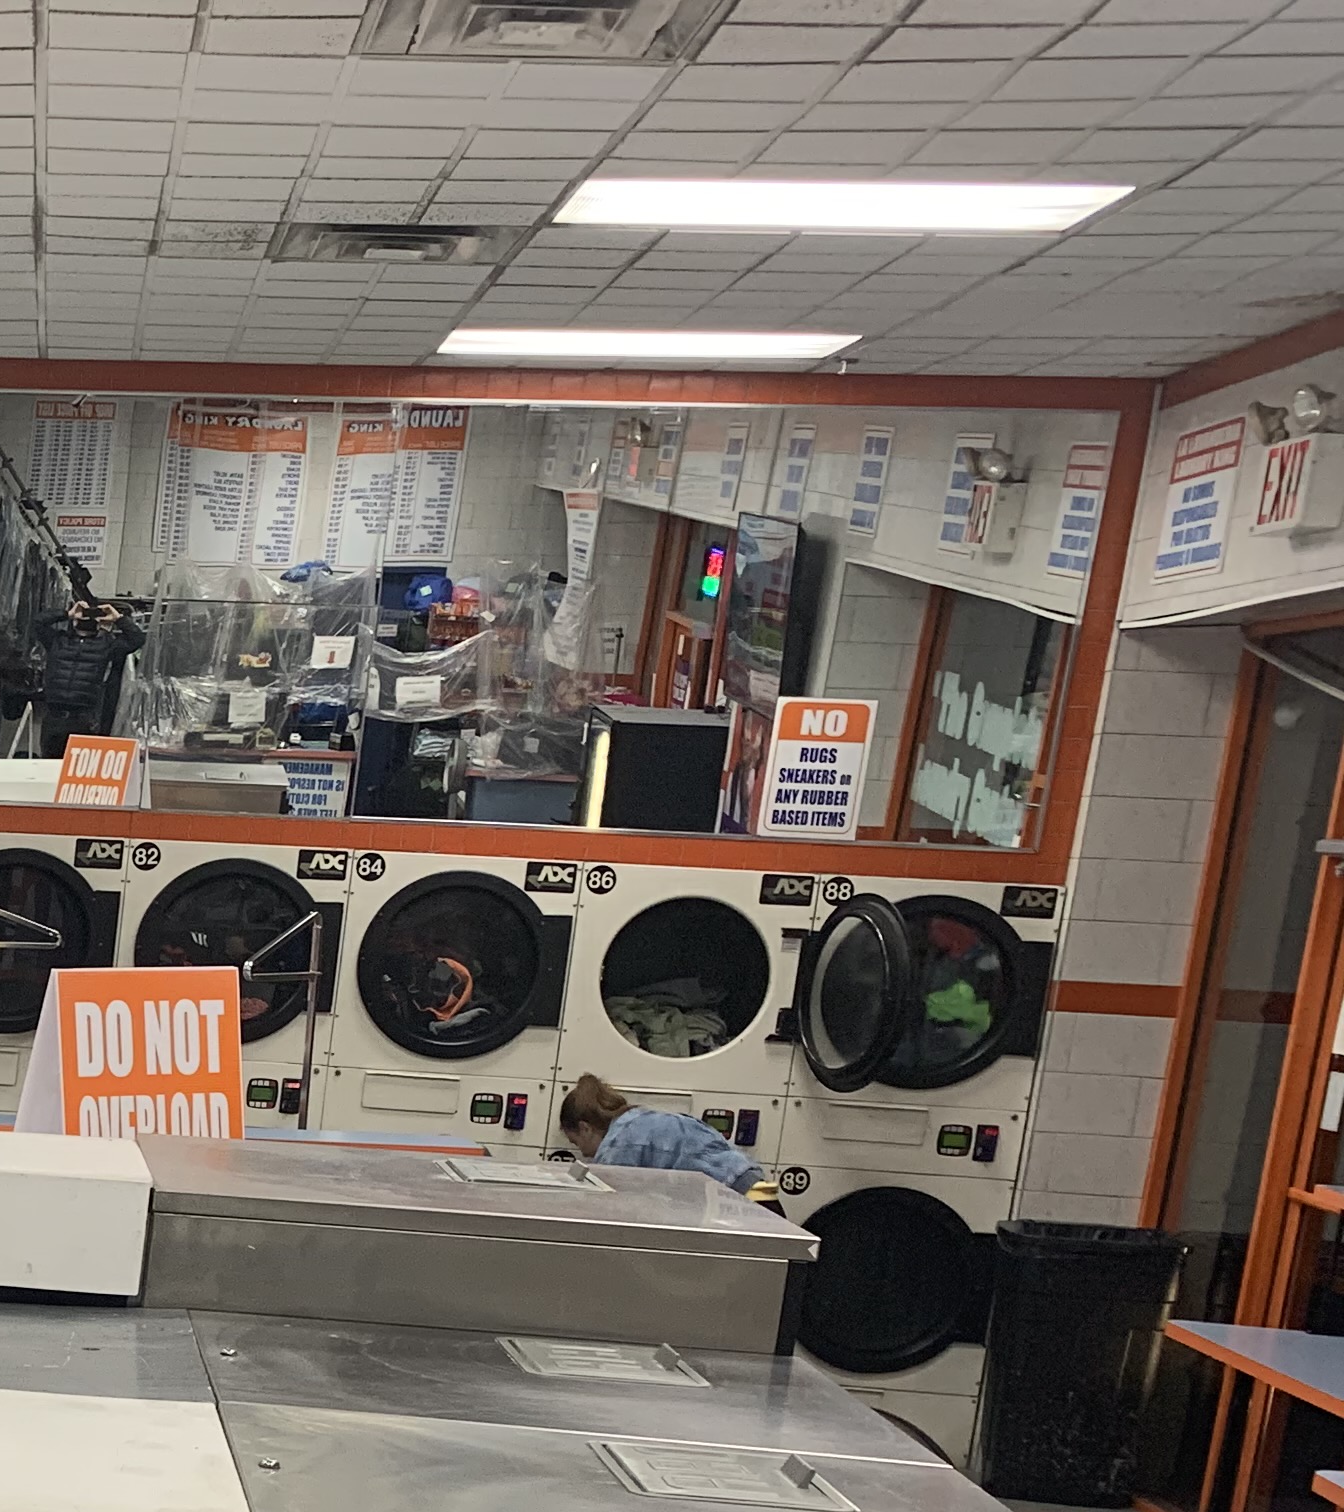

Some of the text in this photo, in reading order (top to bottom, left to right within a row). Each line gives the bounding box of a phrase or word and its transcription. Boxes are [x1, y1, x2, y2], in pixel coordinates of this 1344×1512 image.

[1256, 439, 1311, 526] EXIT
[800, 709, 849, 737] NO
[800, 748, 838, 763] RUGS
[779, 768, 851, 785] SNEAKERS OR
[775, 789, 849, 806] ANY RUBBER
[772, 810, 846, 828] BASED ITEMS
[134, 847, 158, 866] 82
[359, 857, 382, 877] 84
[589, 870, 613, 890] 86
[825, 882, 850, 900] 88
[74, 999, 224, 1077] DO NOT
[79, 1092, 230, 1139] OVERLOAD
[783, 1171, 807, 1190] 89
